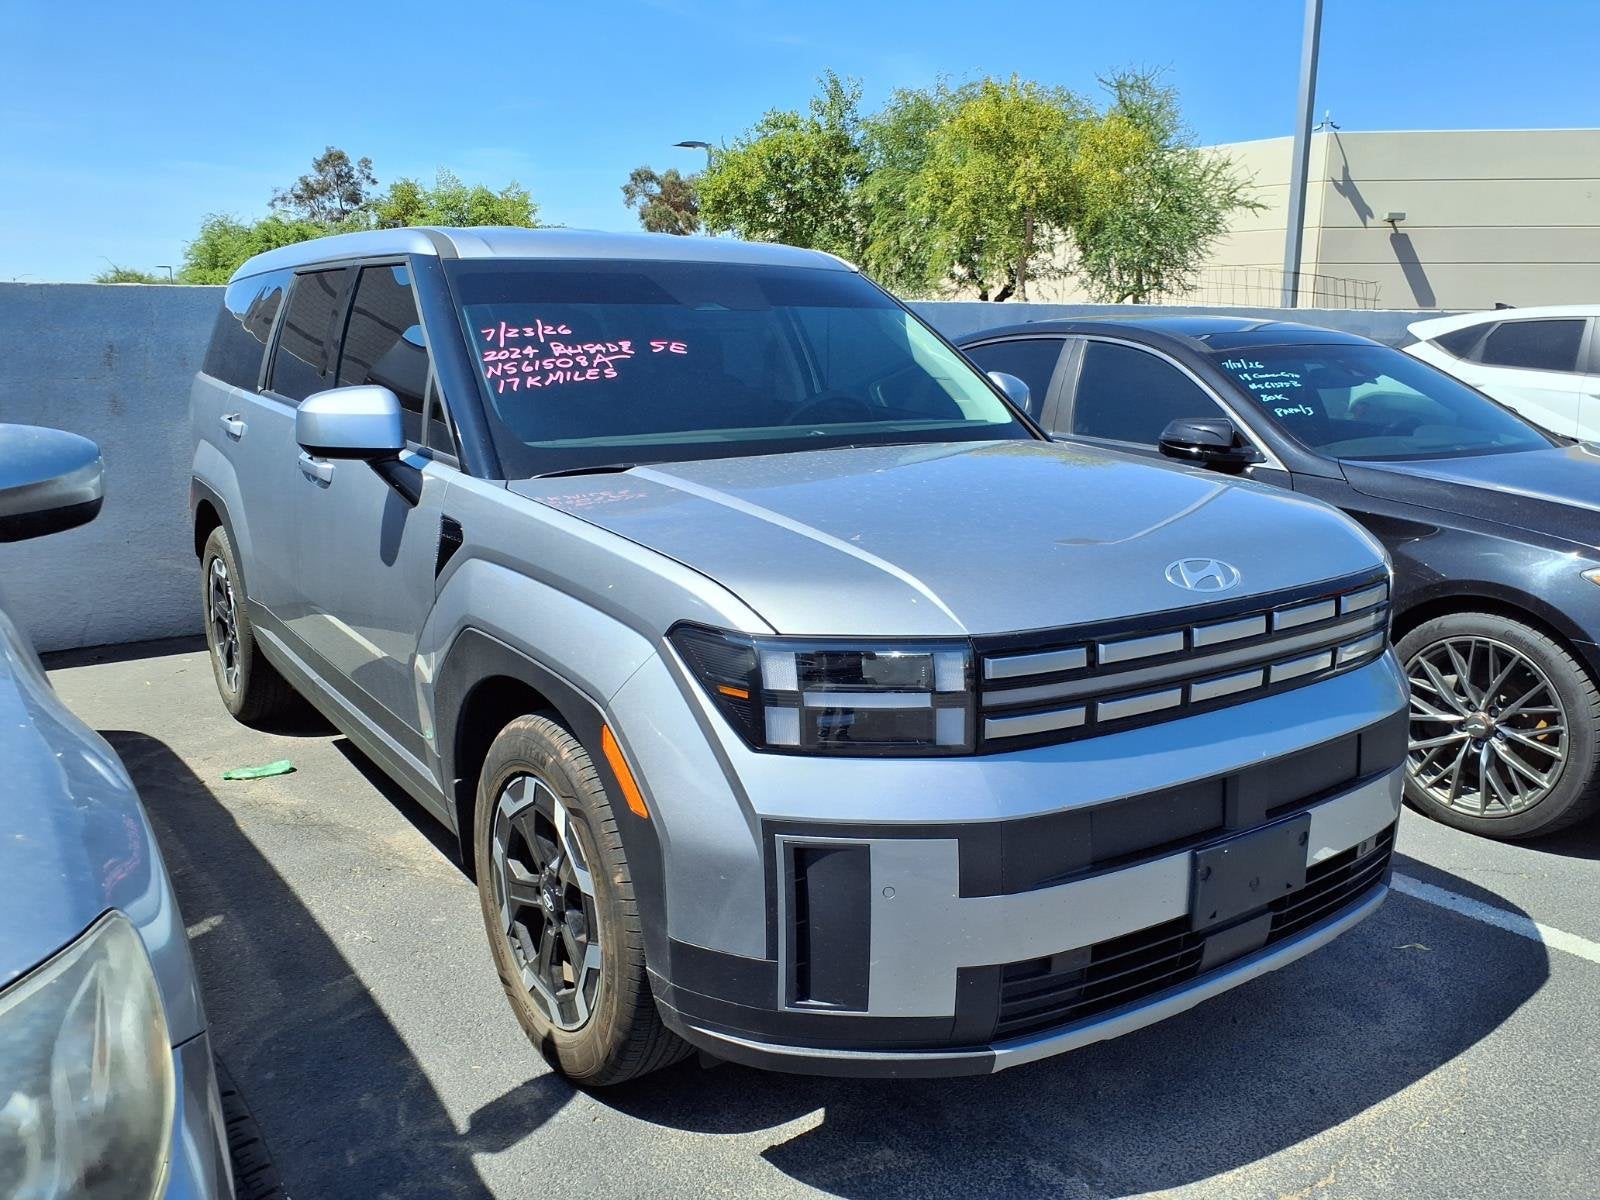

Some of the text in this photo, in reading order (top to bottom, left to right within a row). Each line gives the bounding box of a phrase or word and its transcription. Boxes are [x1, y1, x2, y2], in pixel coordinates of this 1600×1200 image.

[481, 319, 572, 347] 7/23/26
[483, 345, 539, 362] 2024
[650, 341, 688, 354] SE
[486, 353, 631, 379] NS61508A
